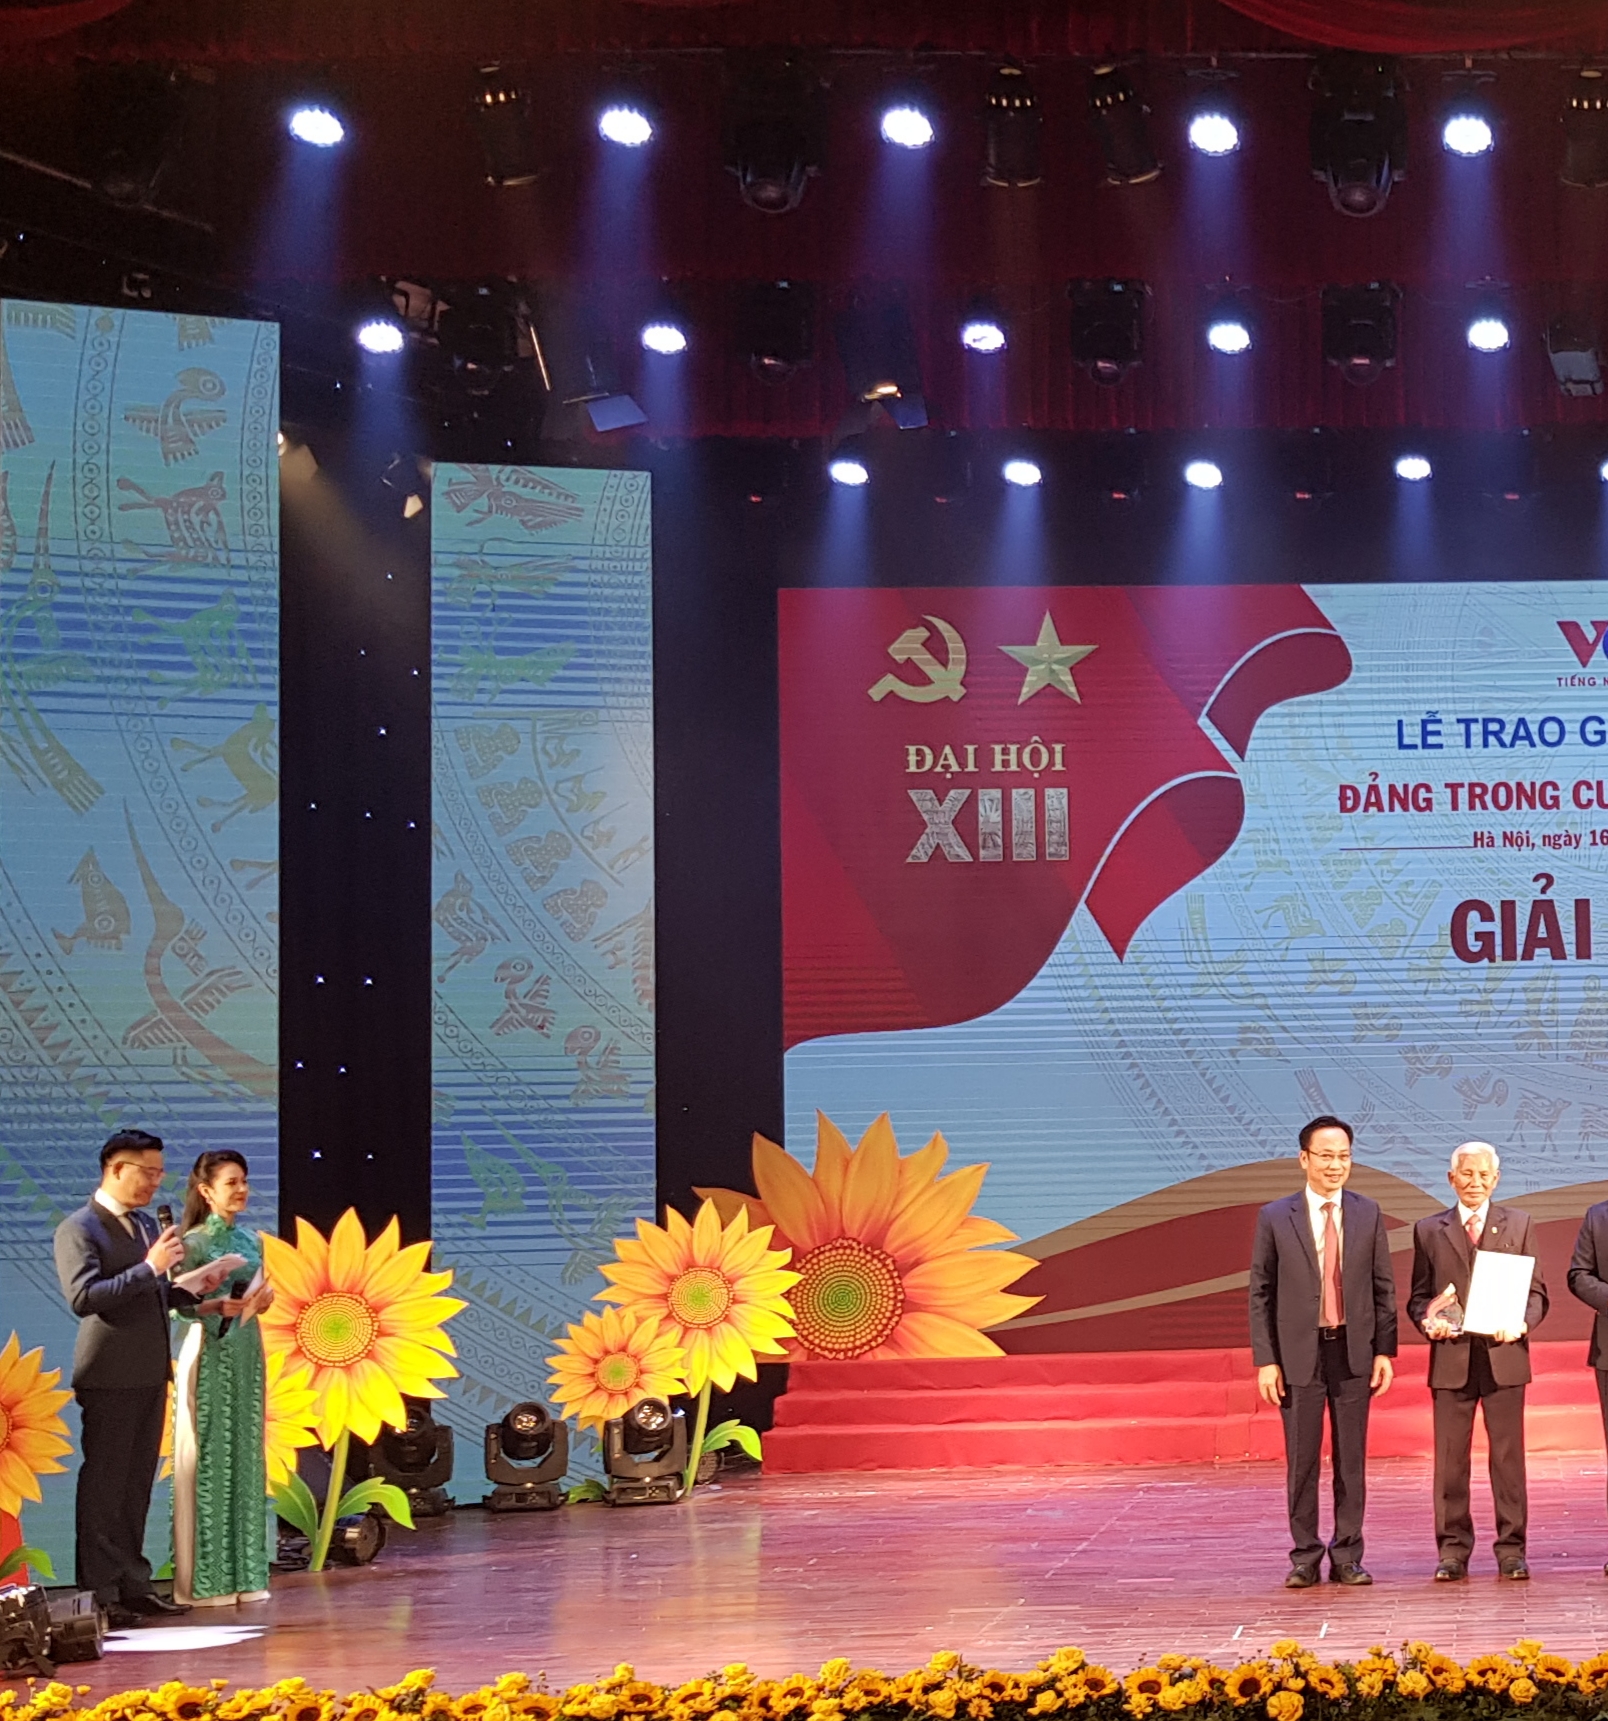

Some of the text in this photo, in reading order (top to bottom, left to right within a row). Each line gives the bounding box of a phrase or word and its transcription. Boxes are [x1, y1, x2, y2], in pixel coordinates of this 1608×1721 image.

[1556, 674, 1597, 687] TIẾNG
[1397, 710, 1444, 750] LỄ
[1456, 716, 1566, 749] TRAO
[905, 735, 1067, 779] ĐẠI HỘI
[1338, 771, 1434, 813] ĐẢNG
[1444, 781, 1561, 812] TRONG
[905, 788, 1070, 862] XIII
[1473, 831, 1495, 848] Hà
[1502, 830, 1536, 851] Nội,
[1541, 829, 1582, 849] ngày
[1450, 872, 1592, 963] GIẢI
